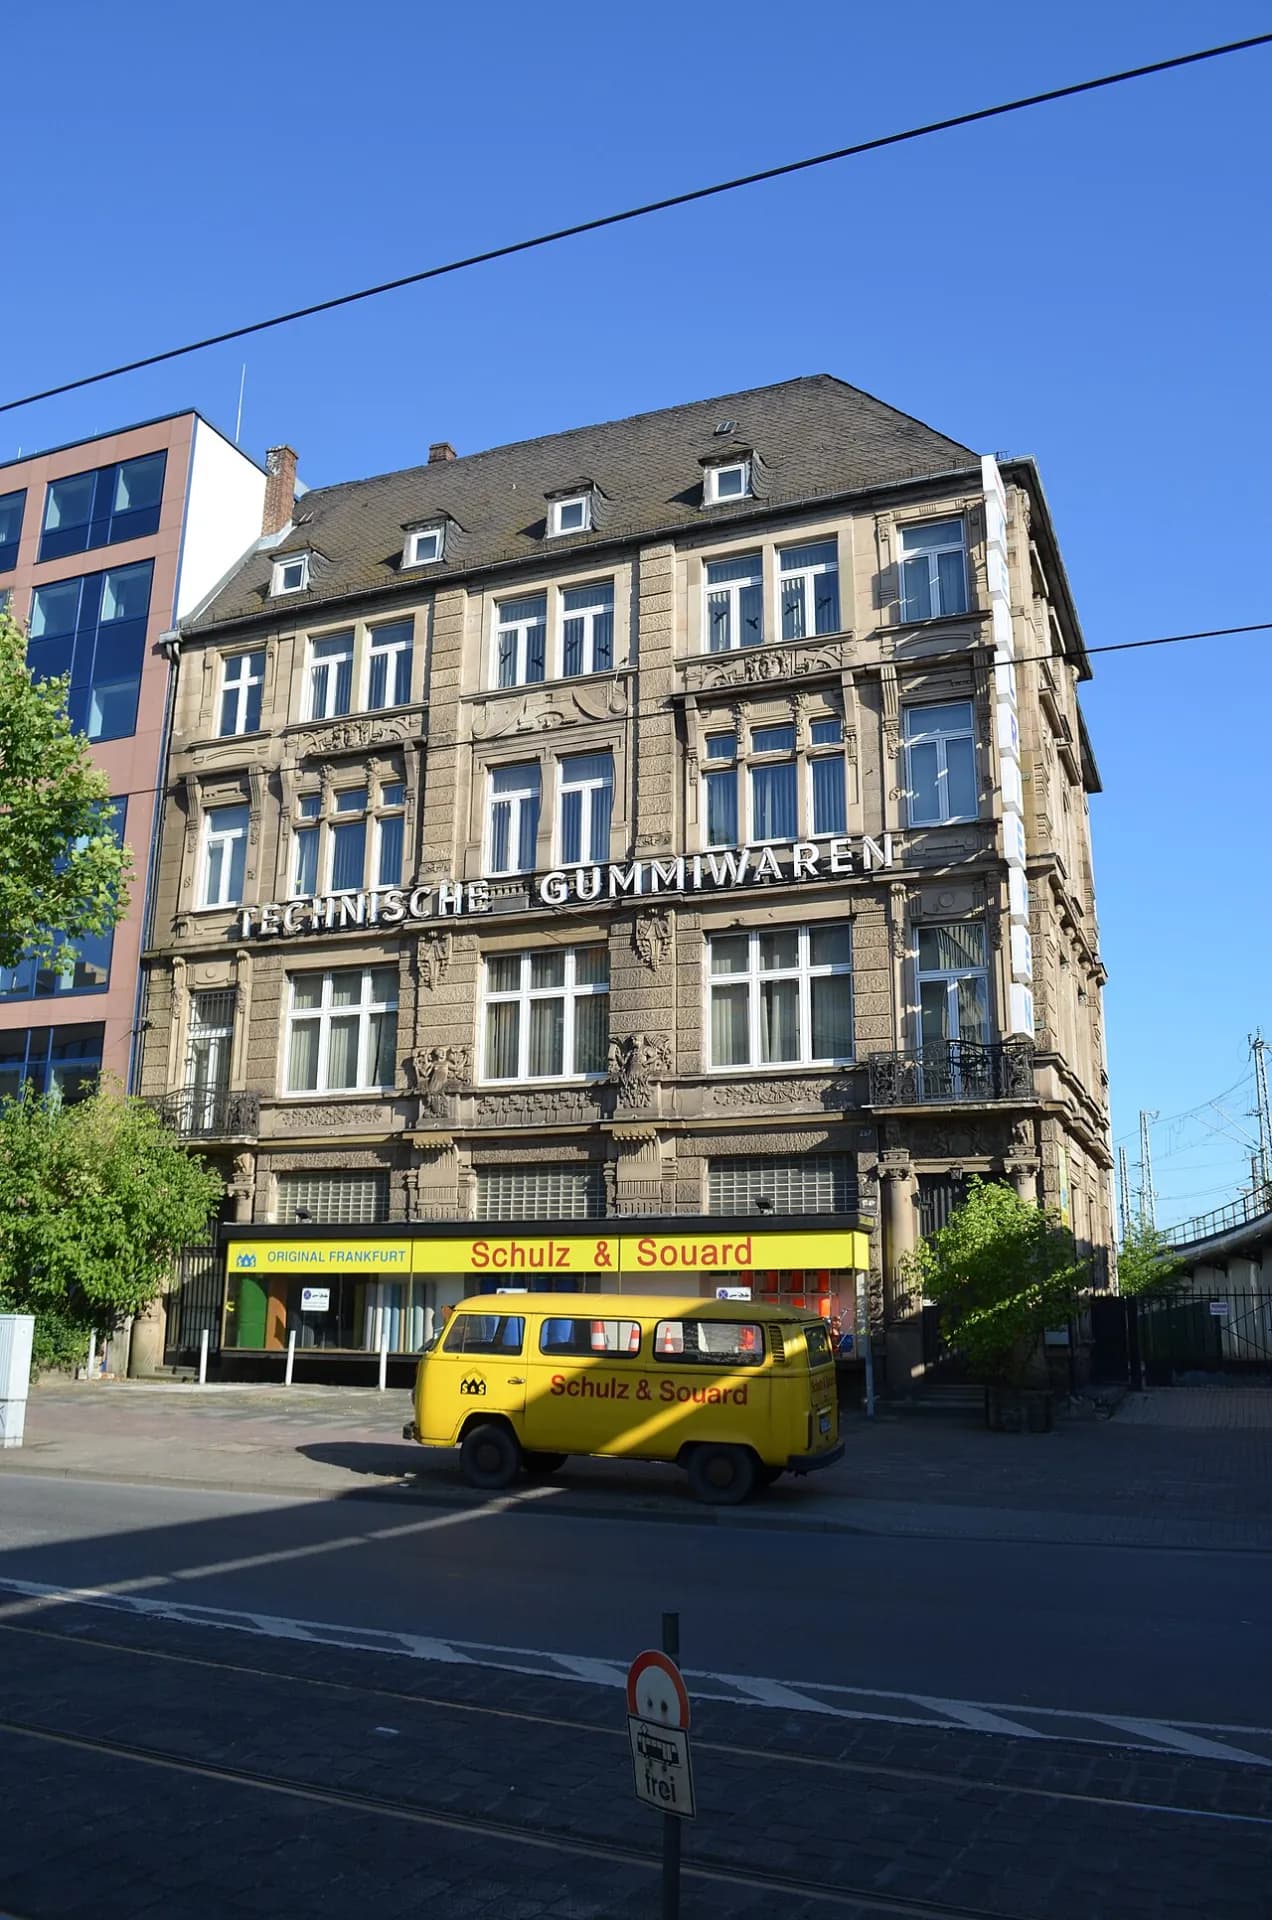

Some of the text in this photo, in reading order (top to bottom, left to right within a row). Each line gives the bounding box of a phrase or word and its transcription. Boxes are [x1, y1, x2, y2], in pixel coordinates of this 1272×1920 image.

[238, 833, 893, 939] TECHNISCHE GUMMIWAREN
[267, 1250, 406, 1263] ORIGINAL FRANKFURT
[471, 1236, 752, 1268] Schulz & Souard
[550, 1375, 748, 1405] Schulz & Souard
[645, 1768, 676, 1803] frei
